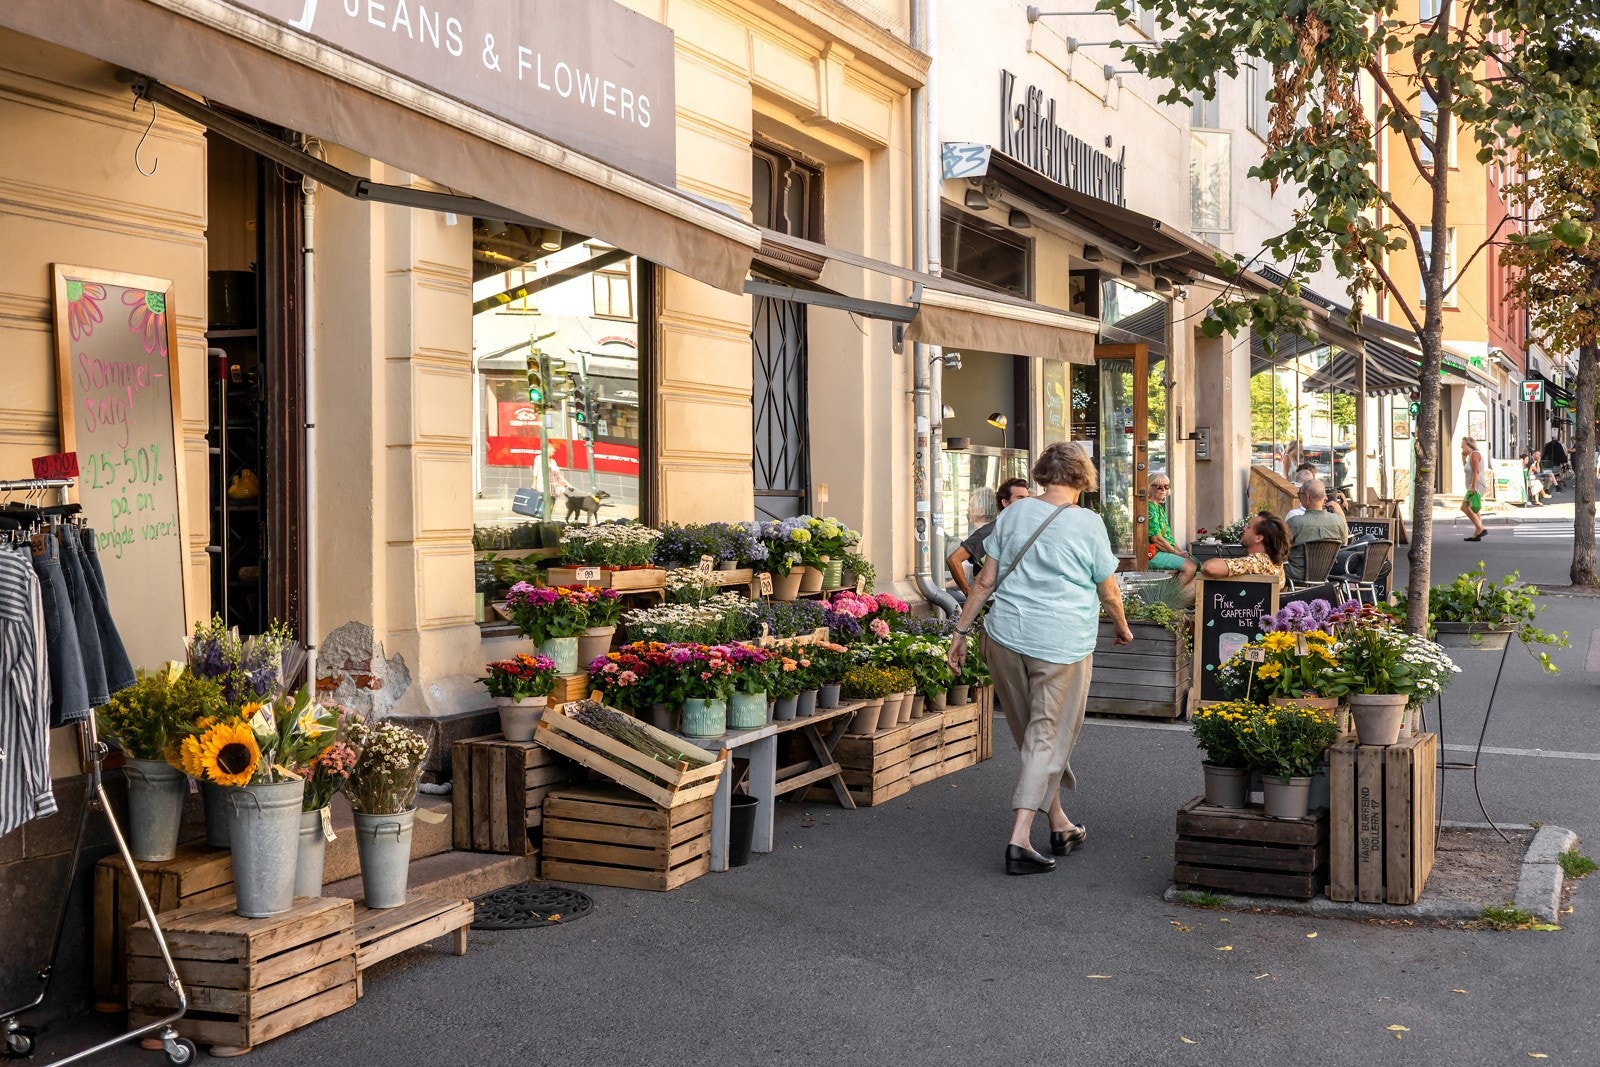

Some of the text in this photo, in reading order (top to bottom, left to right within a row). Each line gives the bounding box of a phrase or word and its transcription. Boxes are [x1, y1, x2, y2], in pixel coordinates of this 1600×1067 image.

[482, 33, 502, 72] &
[518, 45, 651, 128] FLOWERS
[1361, 787, 1369, 863] HANS BURFEIND
